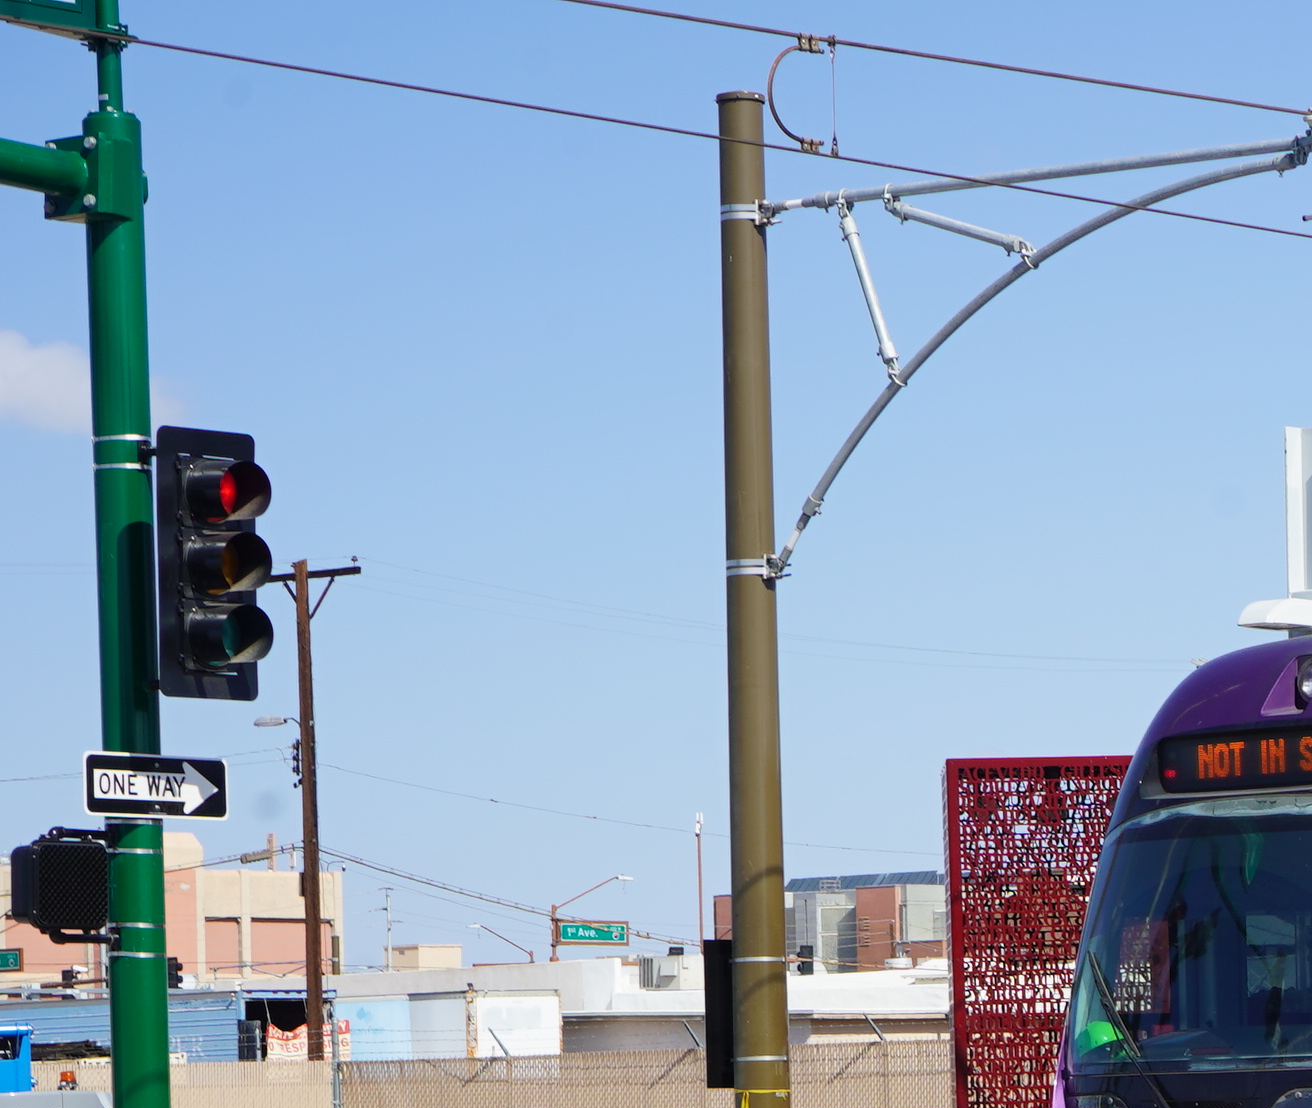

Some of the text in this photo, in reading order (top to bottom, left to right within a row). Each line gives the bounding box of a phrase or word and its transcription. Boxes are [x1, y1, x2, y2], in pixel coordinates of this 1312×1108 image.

[1197, 741, 1245, 779] NOT
[1260, 738, 1286, 775] IN
[99, 772, 186, 798] ONE WAY
[577, 927, 598, 938] Ave.
